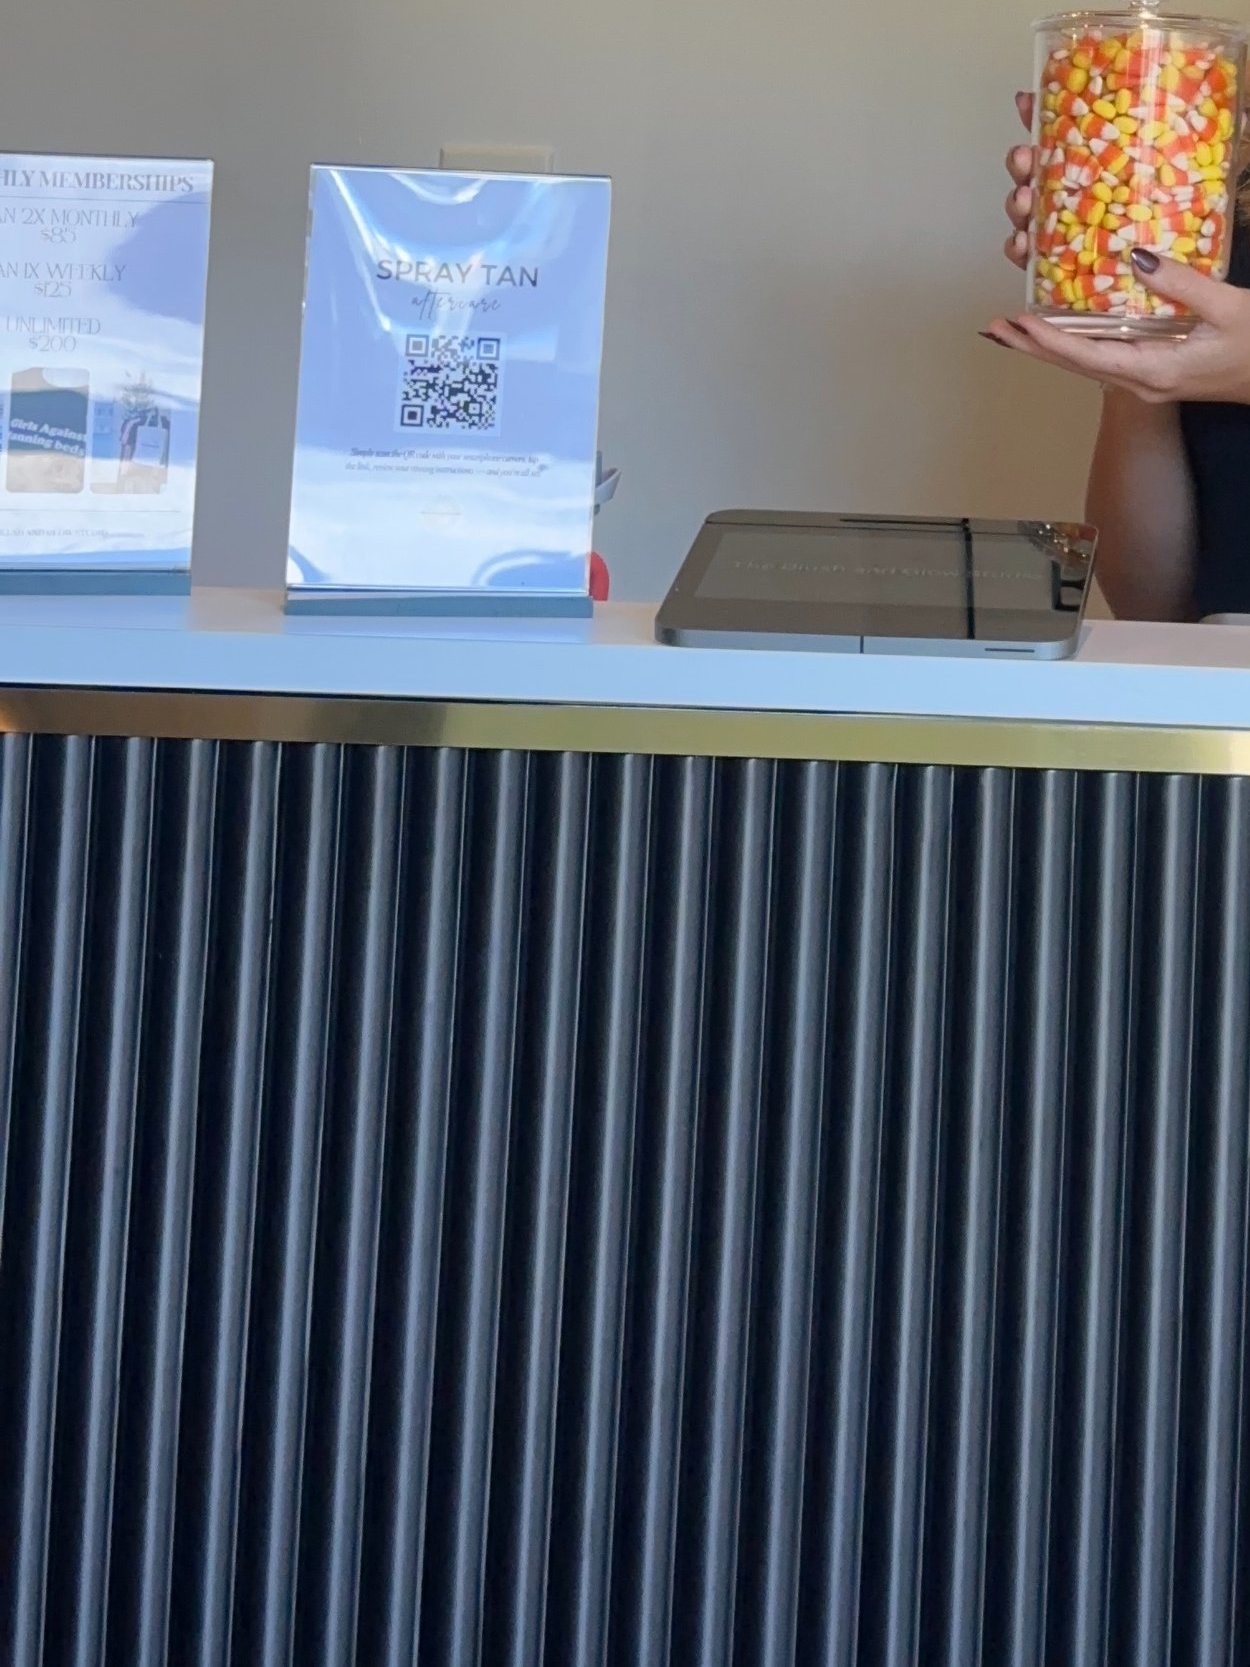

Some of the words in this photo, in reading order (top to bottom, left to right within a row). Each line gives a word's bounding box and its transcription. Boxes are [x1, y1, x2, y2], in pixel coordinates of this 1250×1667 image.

[39, 170, 195, 193] MEMBERSHIPS
[50, 208, 140, 228] MONTHLY
[375, 259, 473, 284] SPRAY
[480, 264, 539, 288] TAN
[6, 314, 102, 335] UNLIMITED
[28, 335, 77, 352] $200
